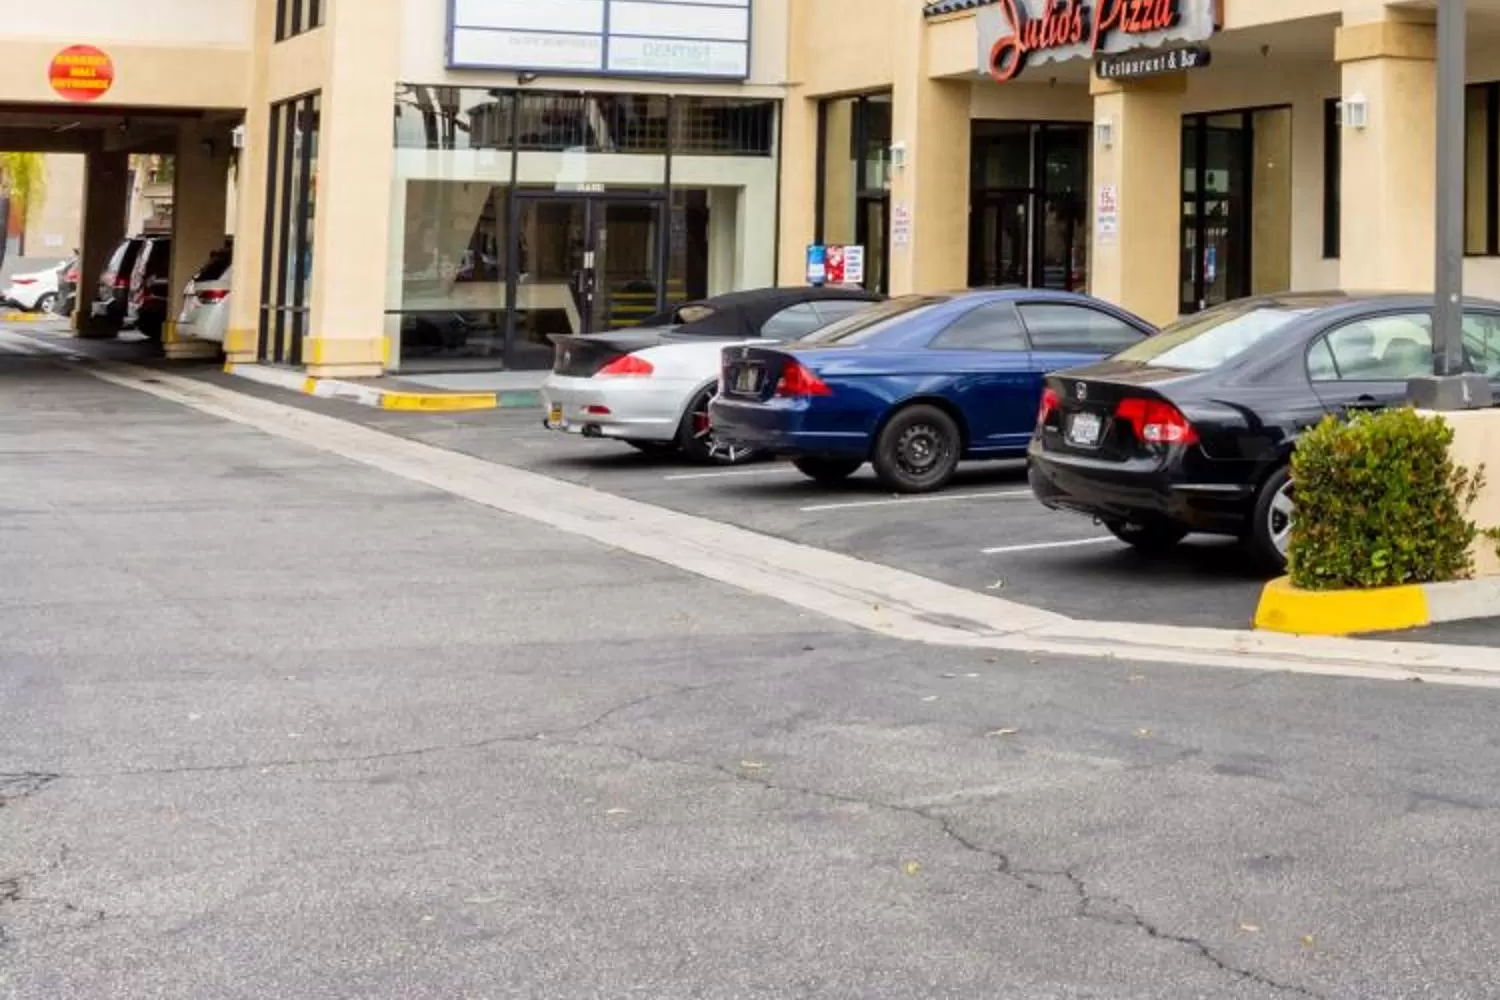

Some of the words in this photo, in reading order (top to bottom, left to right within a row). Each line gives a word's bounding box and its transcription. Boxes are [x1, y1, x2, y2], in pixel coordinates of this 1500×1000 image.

[1100, 56, 1166, 77] Restaurant
[1167, 54, 1177, 69] &
[1180, 50, 1197, 67] Bar
